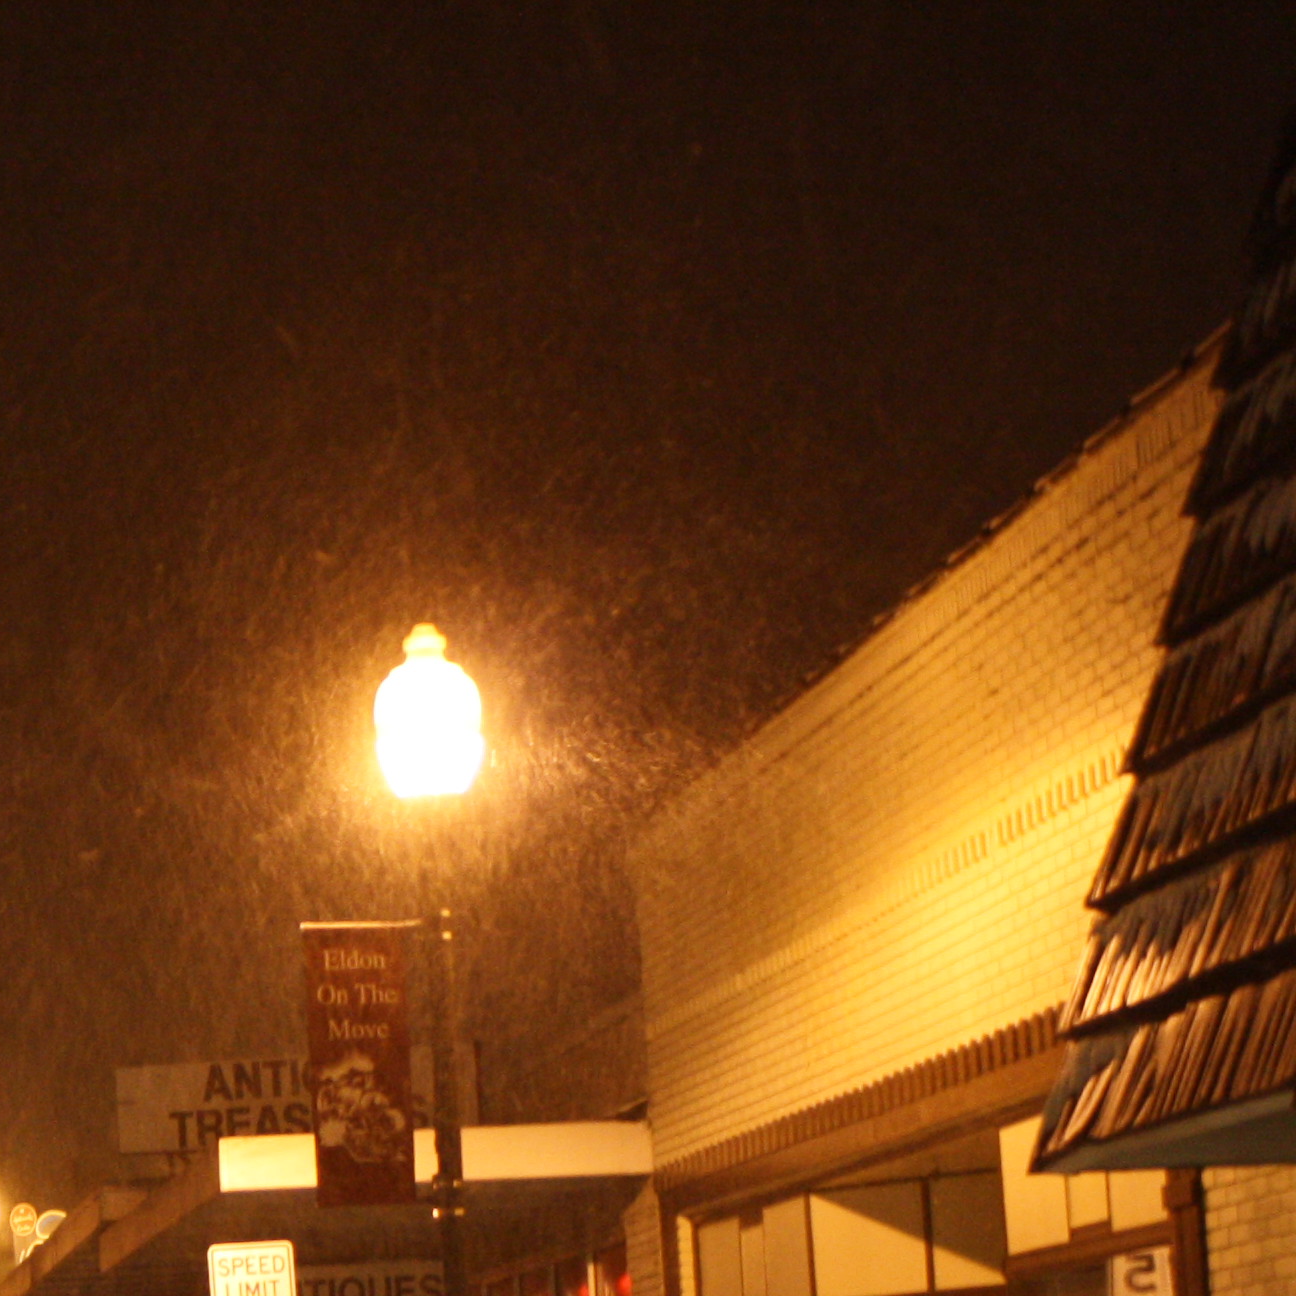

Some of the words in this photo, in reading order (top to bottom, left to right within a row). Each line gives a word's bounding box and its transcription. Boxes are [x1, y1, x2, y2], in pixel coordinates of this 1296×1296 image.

[323, 949, 386, 971] Eldon
[316, 984, 348, 1005] On
[354, 983, 399, 1005] The
[328, 1019, 389, 1040] Move
[204, 1056, 314, 1101] ANTI
[218, 1256, 286, 1277] SPEED
